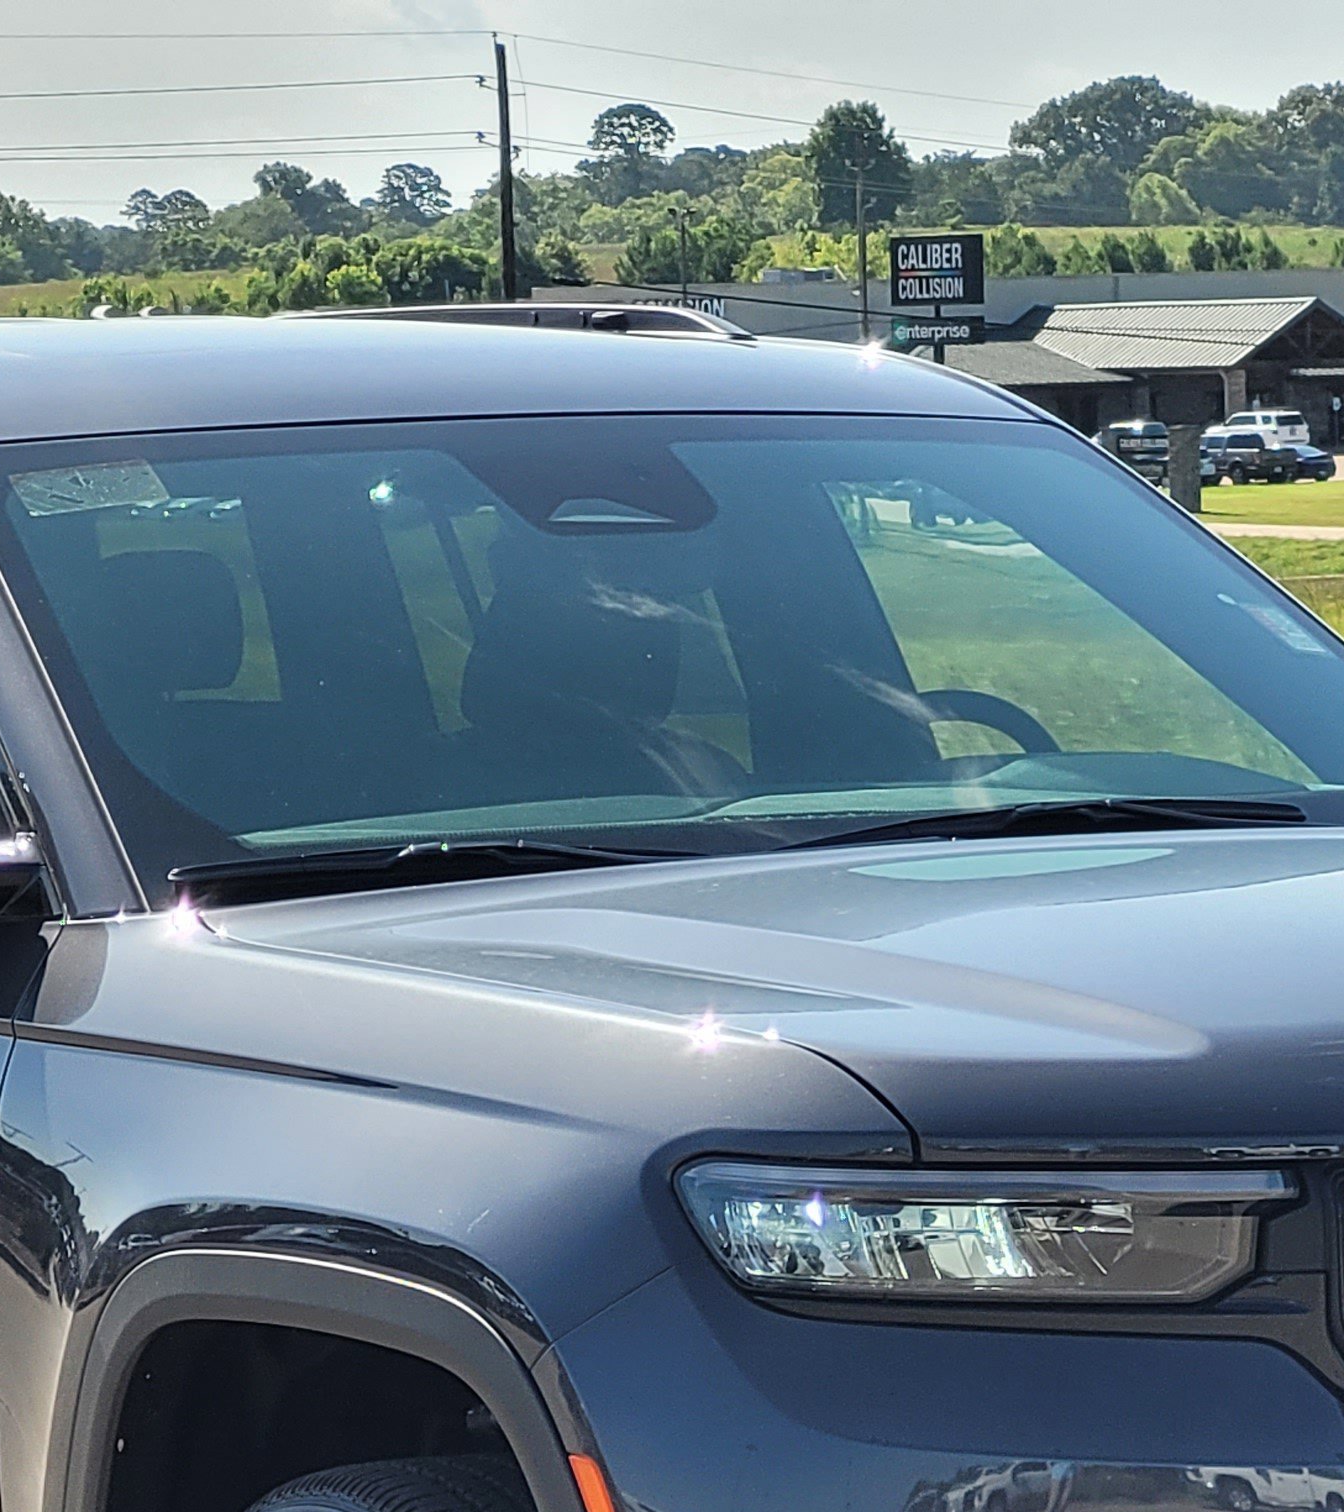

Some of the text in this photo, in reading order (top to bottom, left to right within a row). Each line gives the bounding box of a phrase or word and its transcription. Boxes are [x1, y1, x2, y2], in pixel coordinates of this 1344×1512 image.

[897, 243, 963, 270] CALIBER
[898, 277, 964, 300] COLLISION
[895, 324, 970, 342] enterprise
